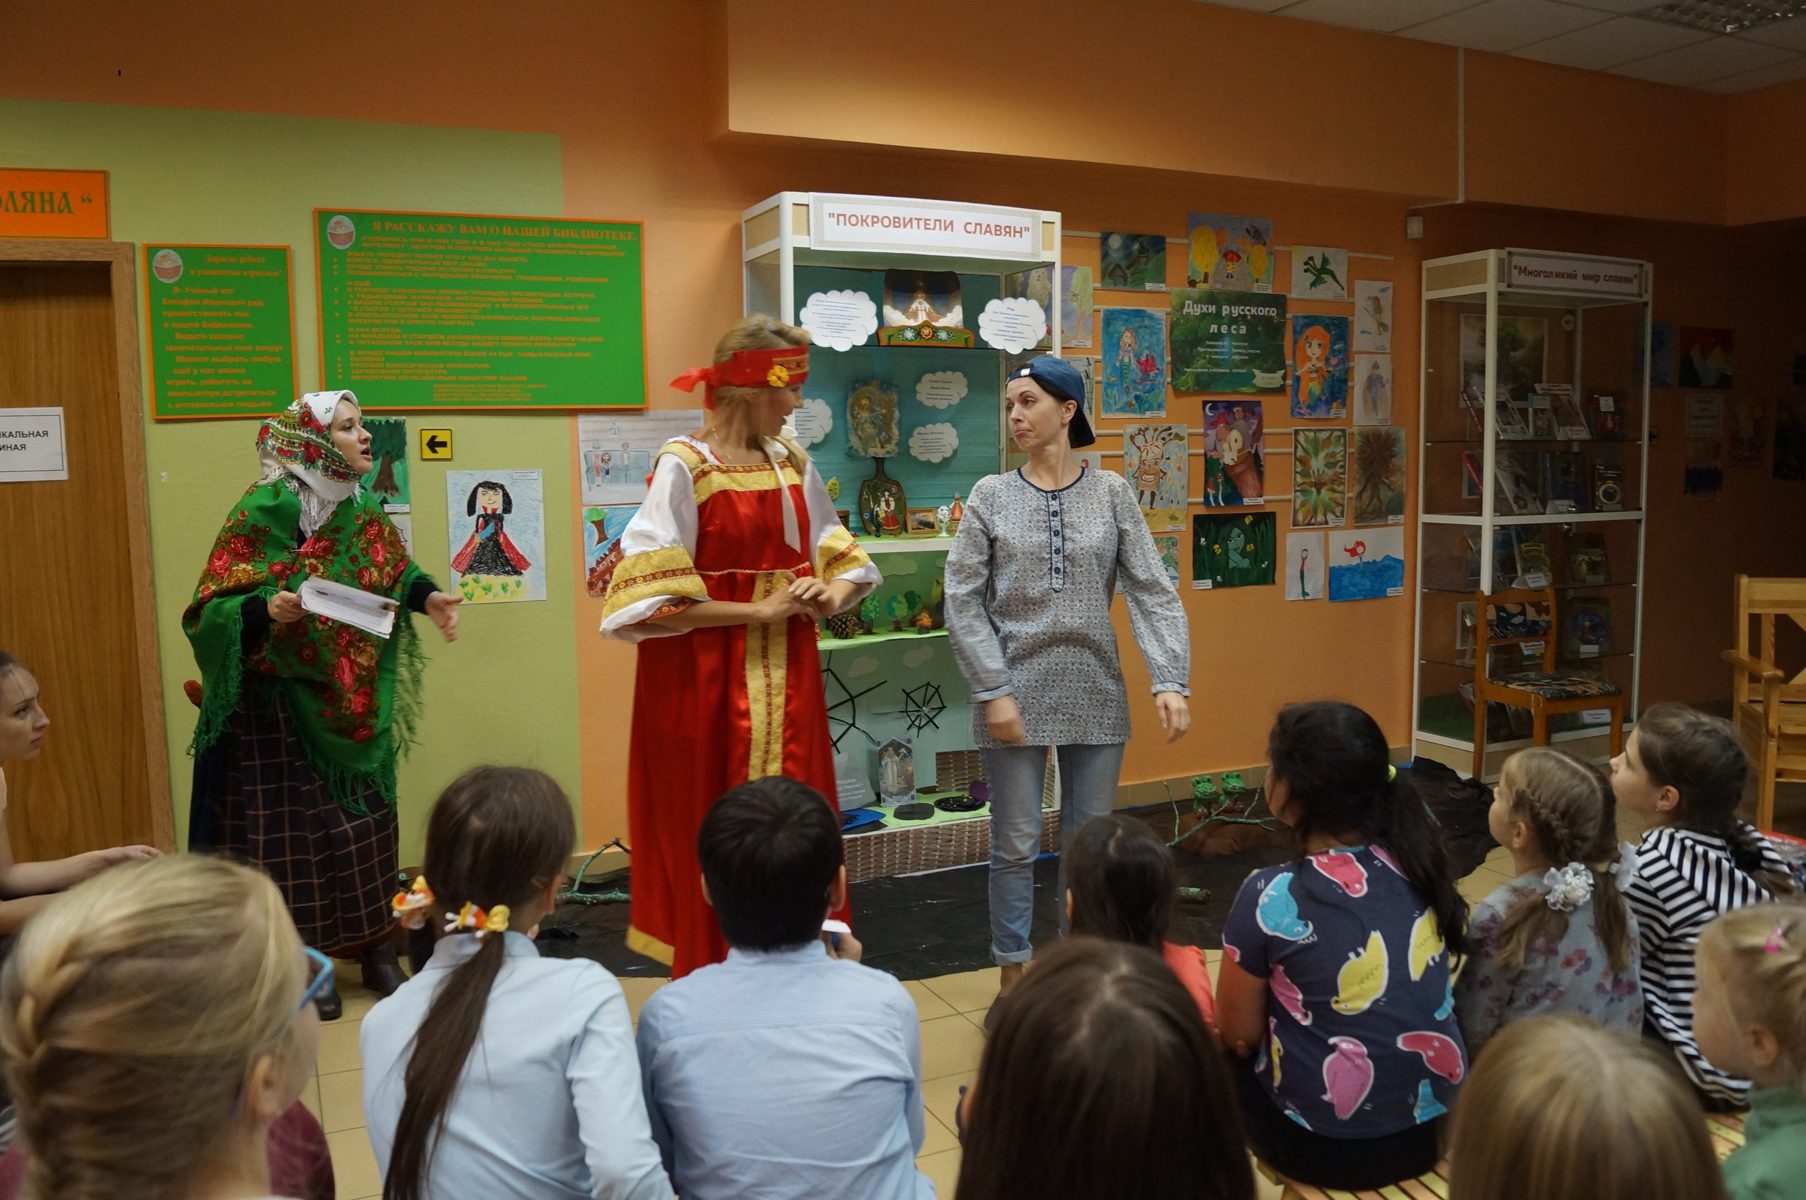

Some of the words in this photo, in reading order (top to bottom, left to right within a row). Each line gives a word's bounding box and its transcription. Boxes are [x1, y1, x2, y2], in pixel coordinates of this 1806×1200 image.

[0, 191, 74, 214] ЛЯНА
[372, 221, 382, 232] Я
[384, 222, 455, 233] РАССКАЖУ
[459, 223, 487, 235] ВАМ
[490, 225, 499, 235] О
[503, 225, 550, 237] НАШЕЙ
[828, 212, 954, 232] "ПОКРОВИТЕЛИ
[964, 221, 1030, 239] СЛАВЯН"
[1513, 264, 1578, 280] "Многоликий
[1582, 272, 1601, 284] мир
[1182, 300, 1216, 315] Духи
[1222, 305, 1277, 317] русского
[1209, 323, 1247, 334] леса
[0, 430, 49, 439] КАЛЬНАЯ
